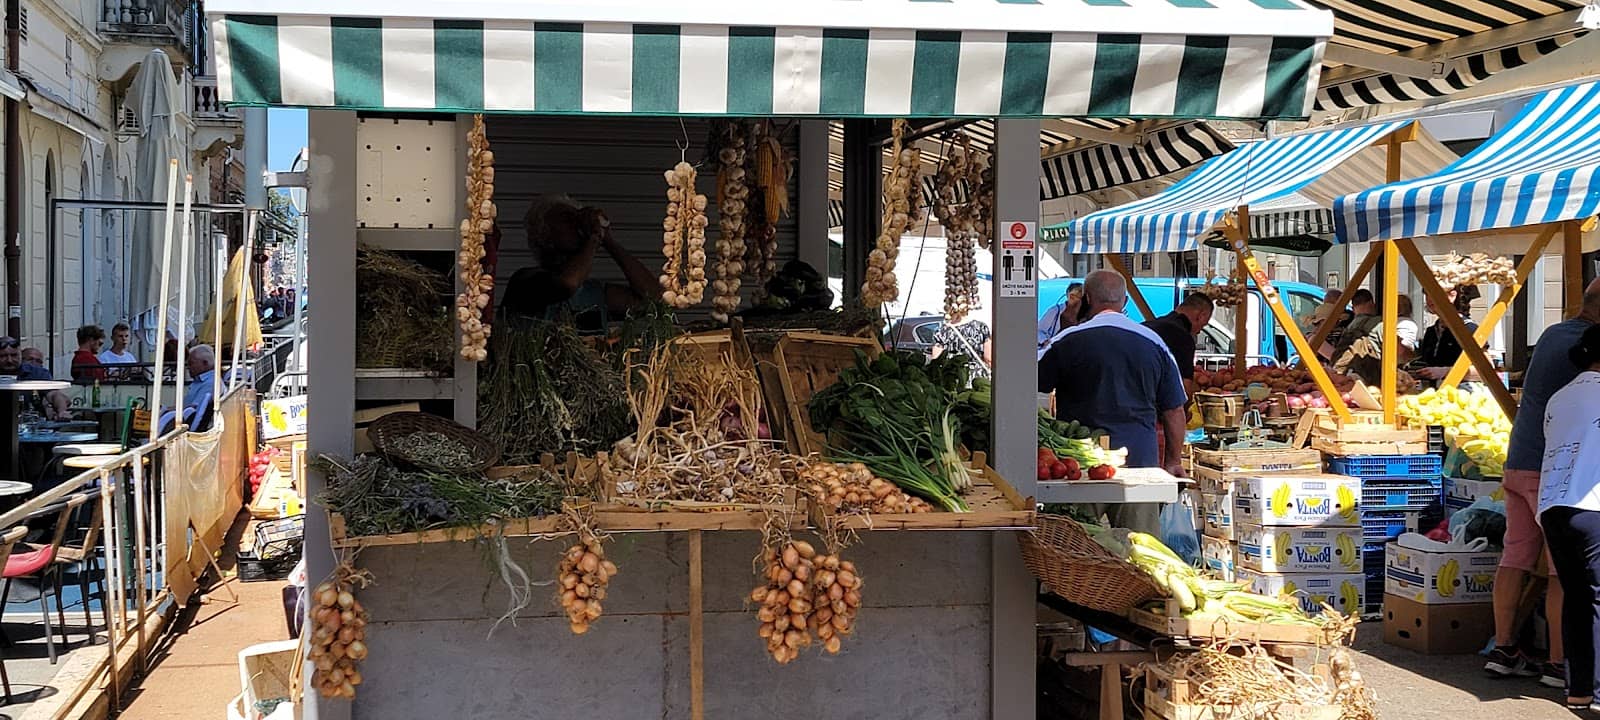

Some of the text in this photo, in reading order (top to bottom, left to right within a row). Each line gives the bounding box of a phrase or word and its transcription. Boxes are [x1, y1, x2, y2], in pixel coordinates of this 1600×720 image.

[1296, 498, 1330, 515] BONITA
[1295, 546, 1331, 563] BONITA
[1463, 575, 1494, 593] ONITA
[1301, 595, 1336, 613] BNITA
